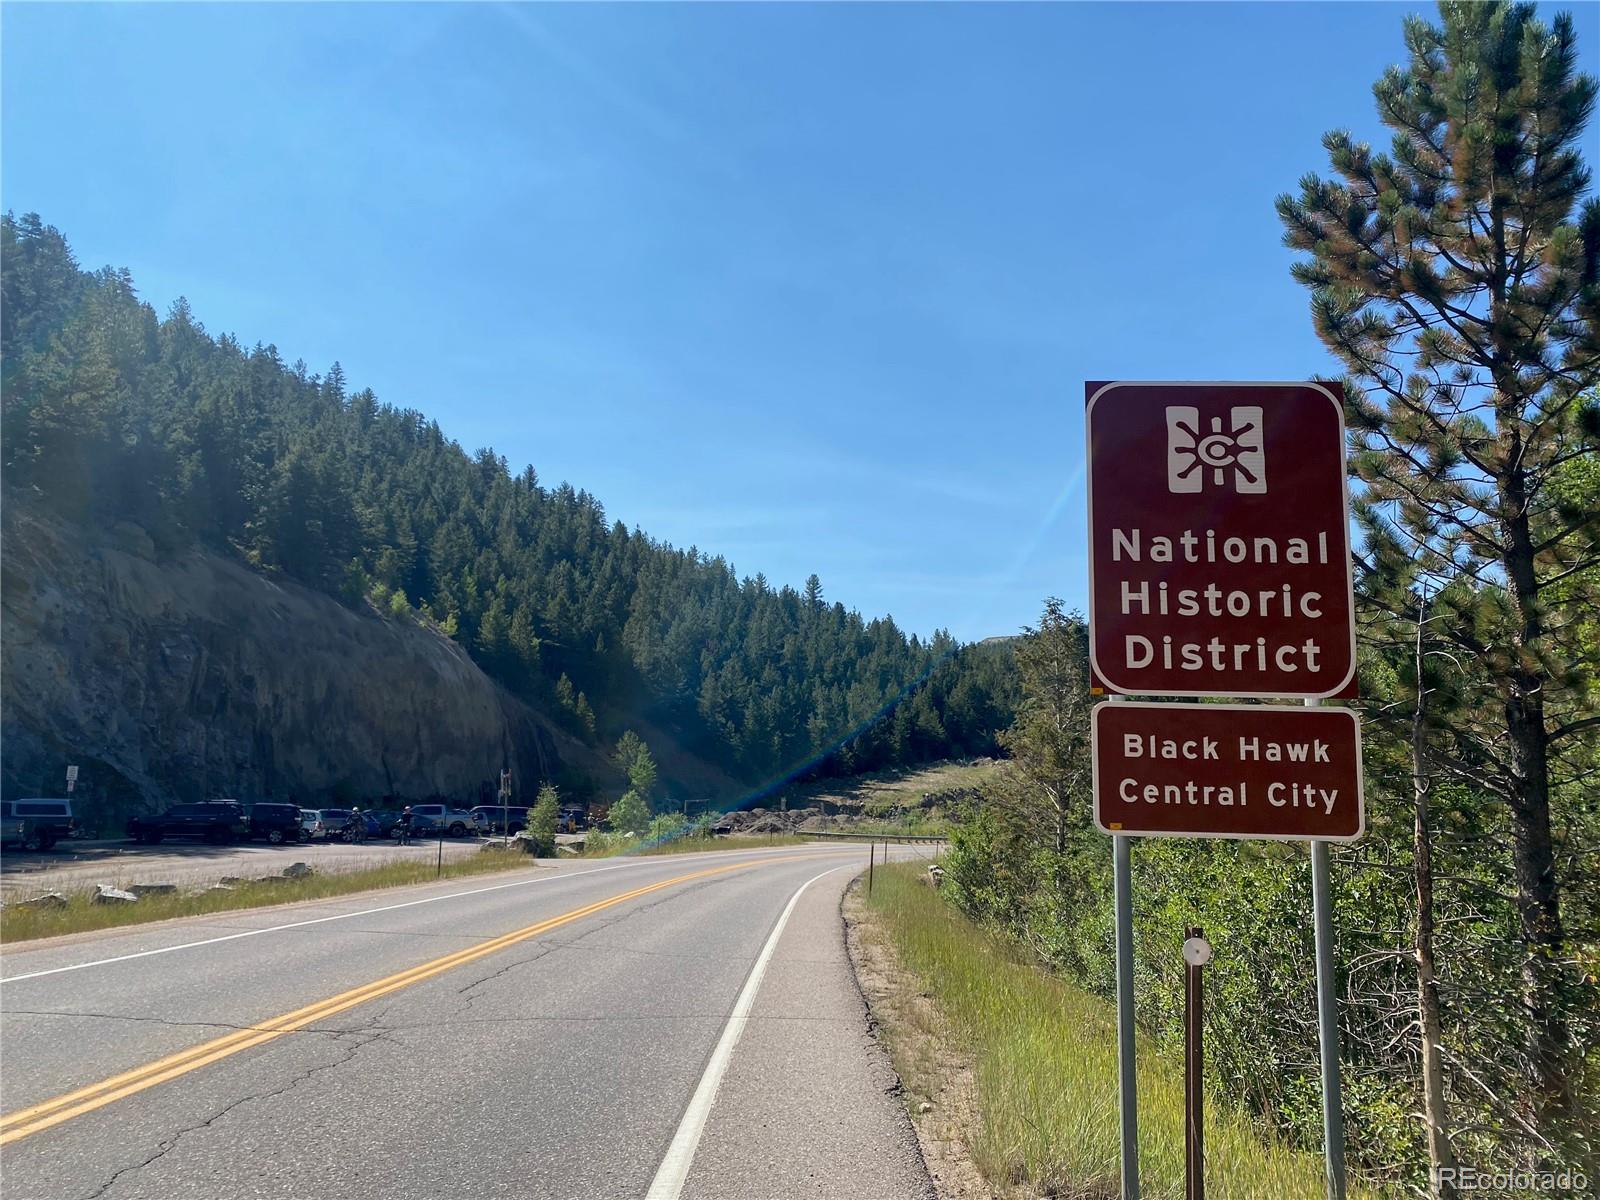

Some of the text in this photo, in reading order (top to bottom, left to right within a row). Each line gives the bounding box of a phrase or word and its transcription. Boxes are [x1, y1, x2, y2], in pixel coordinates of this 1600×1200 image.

[1112, 528, 1328, 564] National
[1121, 581, 1323, 618] Historic
[1125, 635, 1321, 672] District
[1123, 733, 1331, 763] Black Hawk
[1119, 778, 1339, 815] Central City
